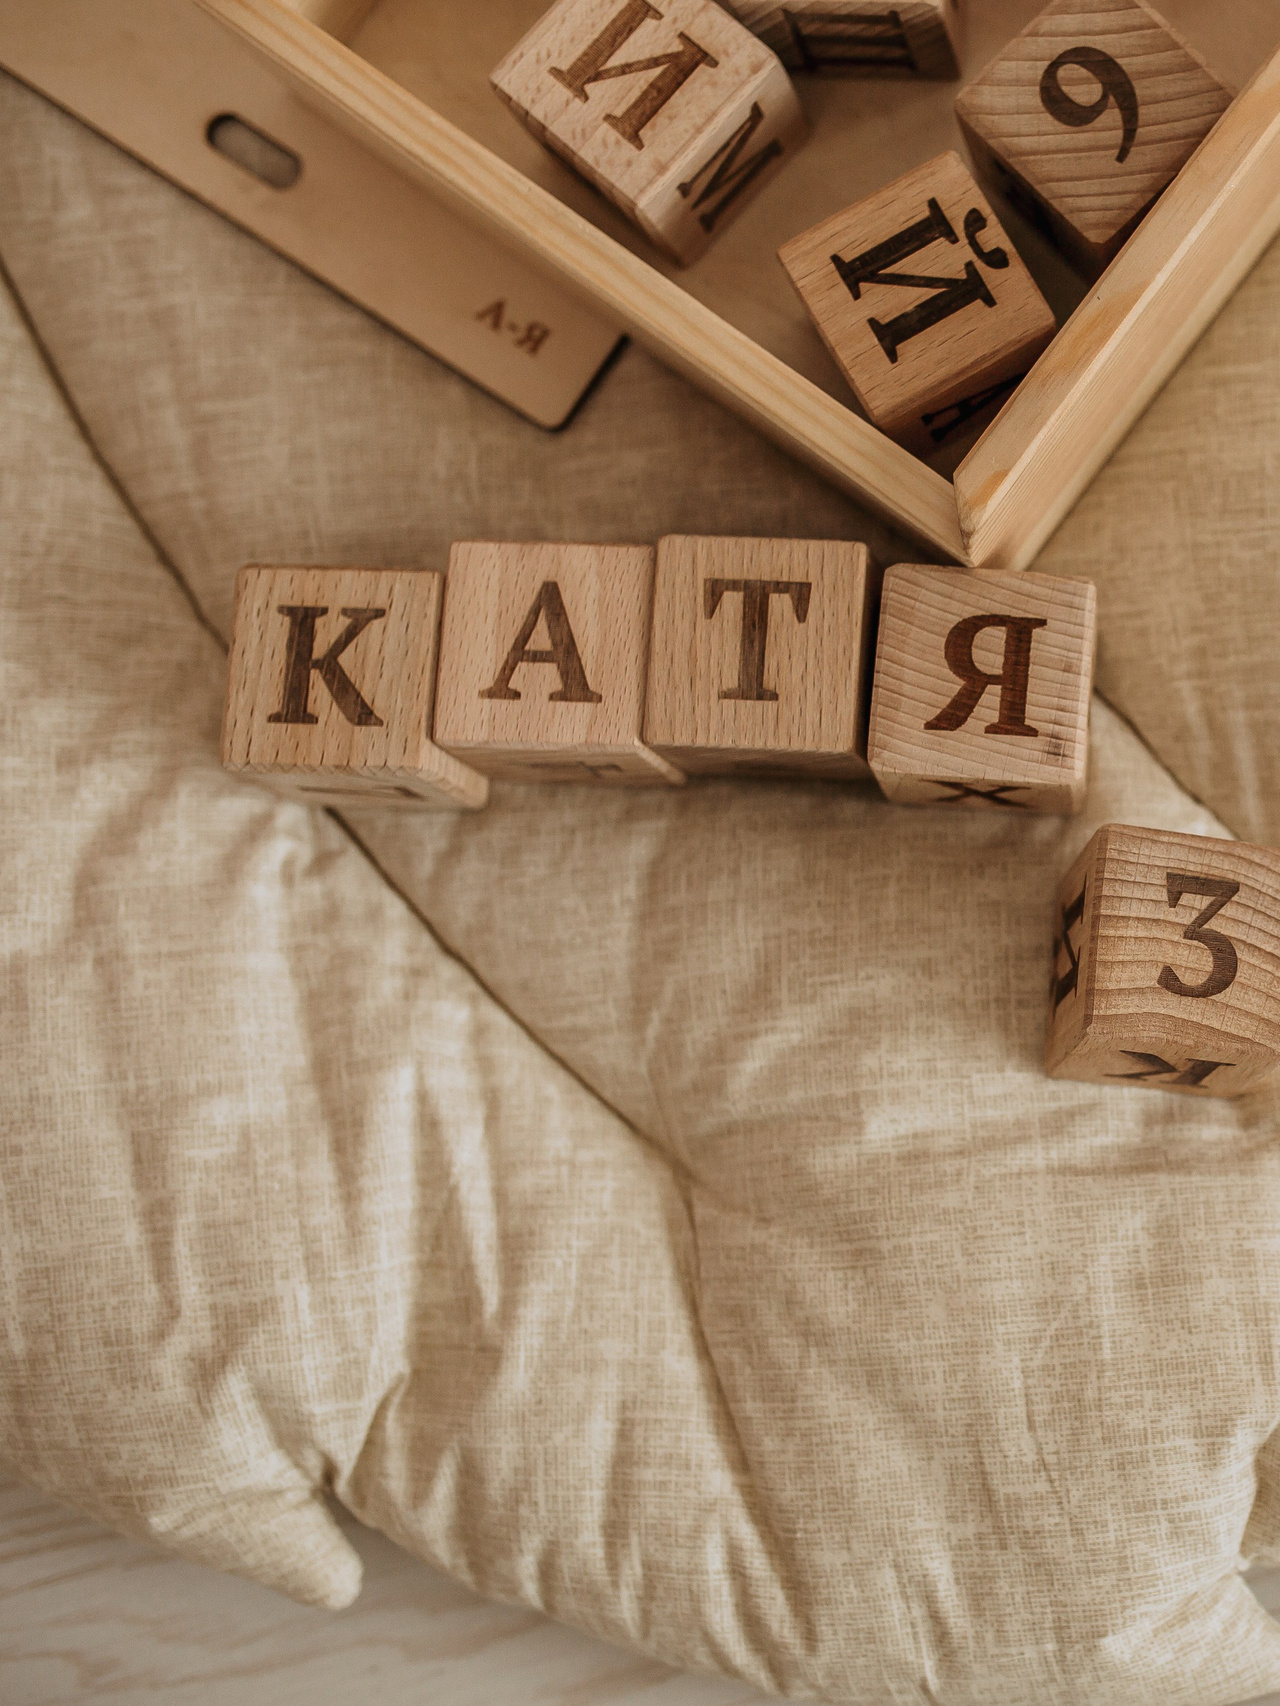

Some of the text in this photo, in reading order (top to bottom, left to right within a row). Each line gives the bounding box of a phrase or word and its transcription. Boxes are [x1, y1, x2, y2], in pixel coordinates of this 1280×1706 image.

[548, 0, 720, 151] И
[830, 197, 1010, 364] Й
[267, 577, 1048, 737] КАТЯ
[1157, 872, 1240, 998] 3
